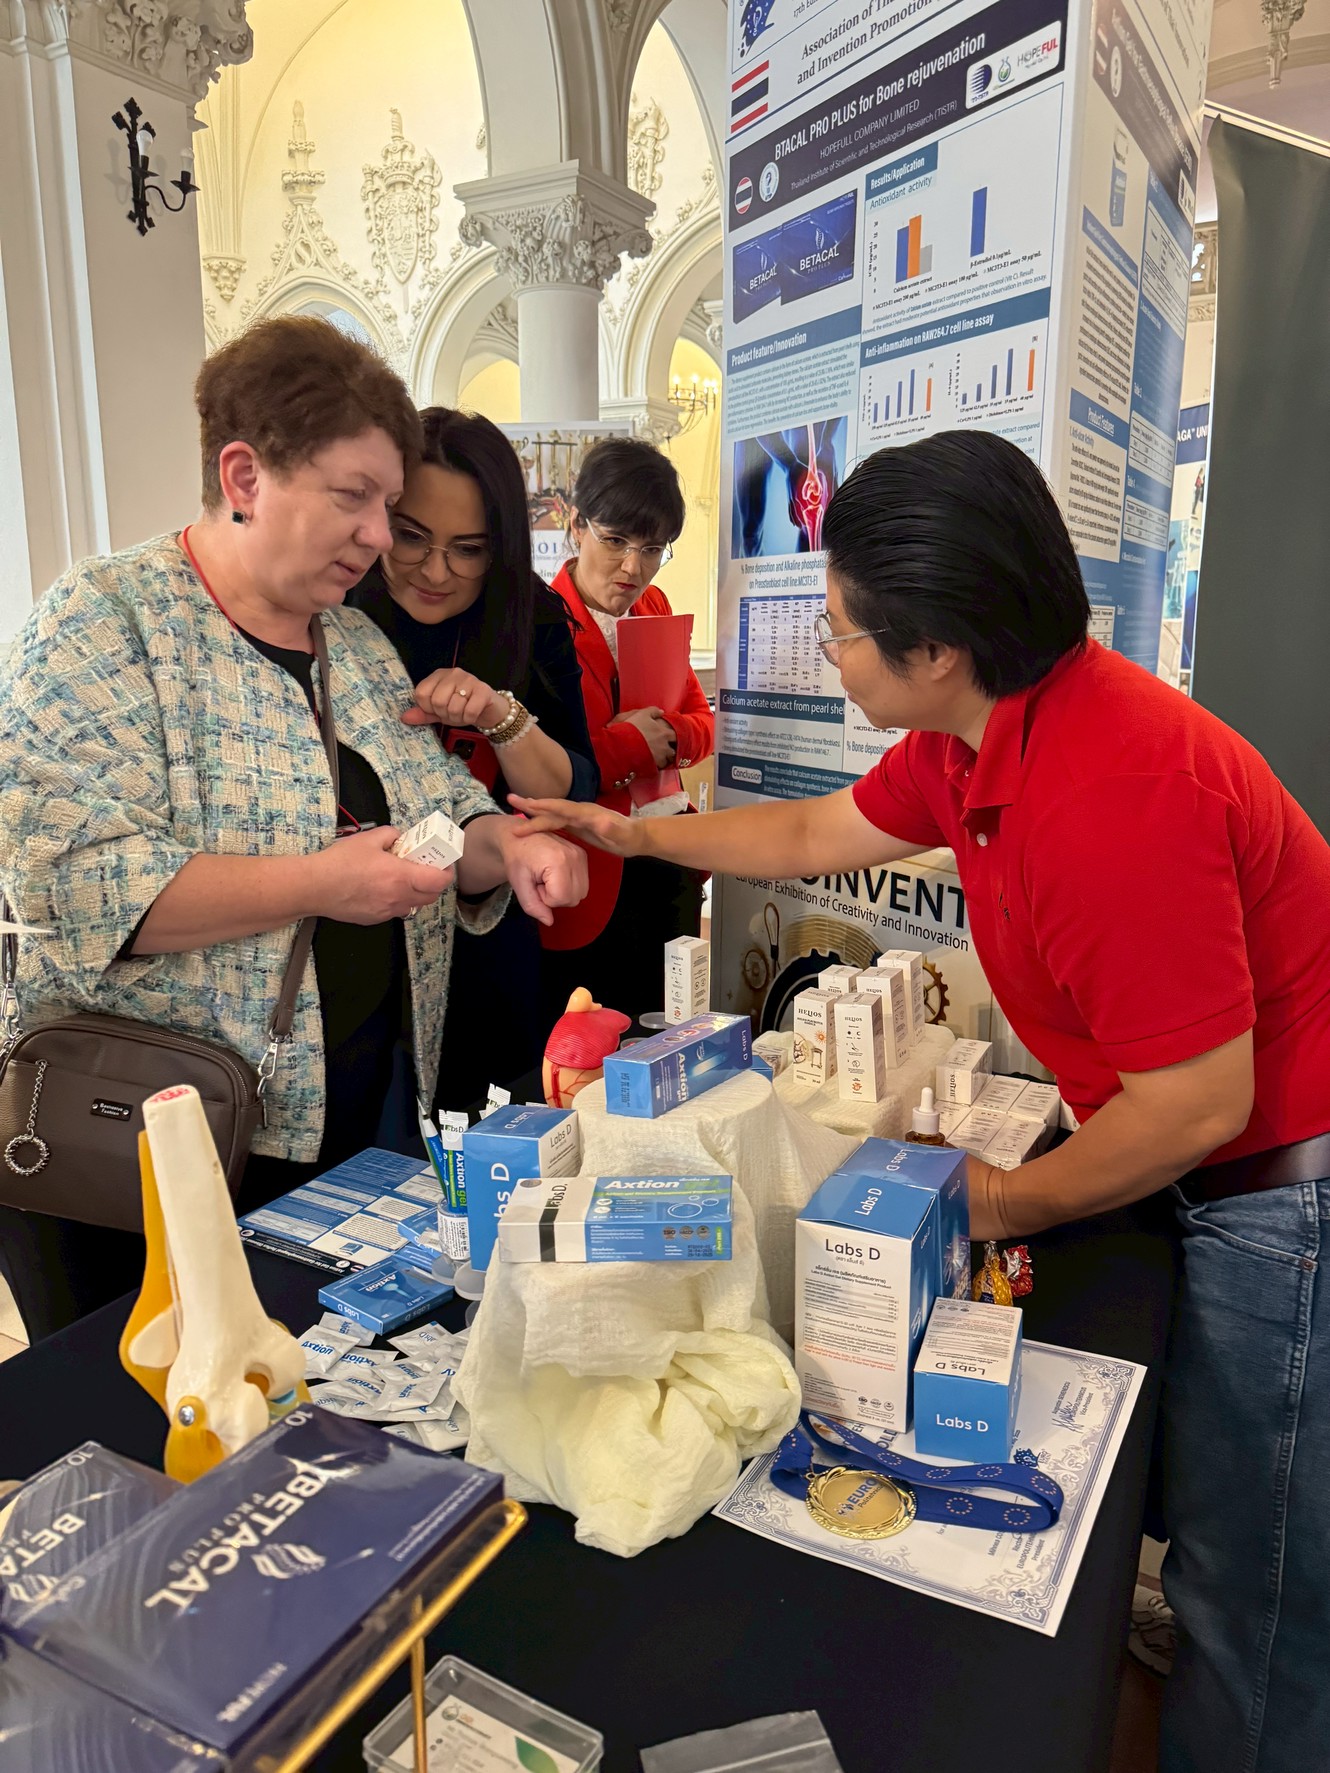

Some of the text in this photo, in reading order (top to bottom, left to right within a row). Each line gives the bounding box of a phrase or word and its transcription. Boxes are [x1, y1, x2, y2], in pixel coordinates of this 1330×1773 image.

[797, 0, 932, 85] and Invention Promotion
[802, 6, 873, 60] Association of
[775, 33, 986, 161] BTACAL PRO PLUS for Bone rejuvenation
[819, 98, 920, 160] HOPEFULL COMPANY LIMITED
[830, 163, 836, 173] of
[858, 147, 869, 159] and
[869, 129, 906, 152] Technological
[906, 113, 934, 134] Research
[934, 99, 959, 120] (TISTR)
[870, 156, 926, 190] Results/Application
[870, 187, 906, 211] Antioxidant
[908, 175, 933, 193] activity
[800, 244, 840, 271] BETACAL
[750, 266, 778, 290] BETACAL
[865, 313, 995, 358] Anti-inflammation on RAW264.7 cell line assay
[731, 332, 807, 367] Product feature/Innovation
[755, 563, 776, 575] deposition
[775, 561, 784, 571] and
[784, 560, 801, 571] Alkaline
[749, 577, 789, 590] on cell
[722, 694, 746, 707] Calcium
[746, 697, 769, 709] acetate
[769, 700, 793, 711] extract
[793, 700, 810, 713] from
[810, 702, 830, 716] pearl
[852, 741, 865, 752] Bone
[732, 768, 762, 780] Conclusion
[775, 881, 818, 905] Exhibition
[819, 896, 831, 908] of
[832, 899, 879, 926] Creativity
[881, 914, 902, 931] and
[904, 920, 969, 951] Innovation
[798, 1008, 823, 1018] HELIOS
[678, 1053, 689, 1100] Axtion
[550, 1124, 572, 1148] Labs D
[456, 1153, 465, 1189] Axtion
[491, 1163, 510, 1182] D
[604, 1180, 680, 1190] Axtion
[854, 1187, 882, 1216] Labs D
[826, 1239, 881, 1260] Labs D
[365, 1274, 397, 1293] Axtion
[337, 1303, 360, 1320] Labs D
[404, 1303, 430, 1321] Labs D
[301, 1340, 333, 1355] Axtion
[342, 1353, 378, 1367] Axtion
[936, 1362, 986, 1375] Labs D
[285, 1410, 314, 1427] 10
[936, 1413, 990, 1432] Labs D
[66, 1450, 94, 1467] 10
[847, 1478, 878, 1505] EURO
[224, 1491, 266, 1526] PRO
[0, 1513, 86, 1576] BETA
[144, 1471, 327, 1609] BETACAL
[1031, 1539, 1045, 1561] President
